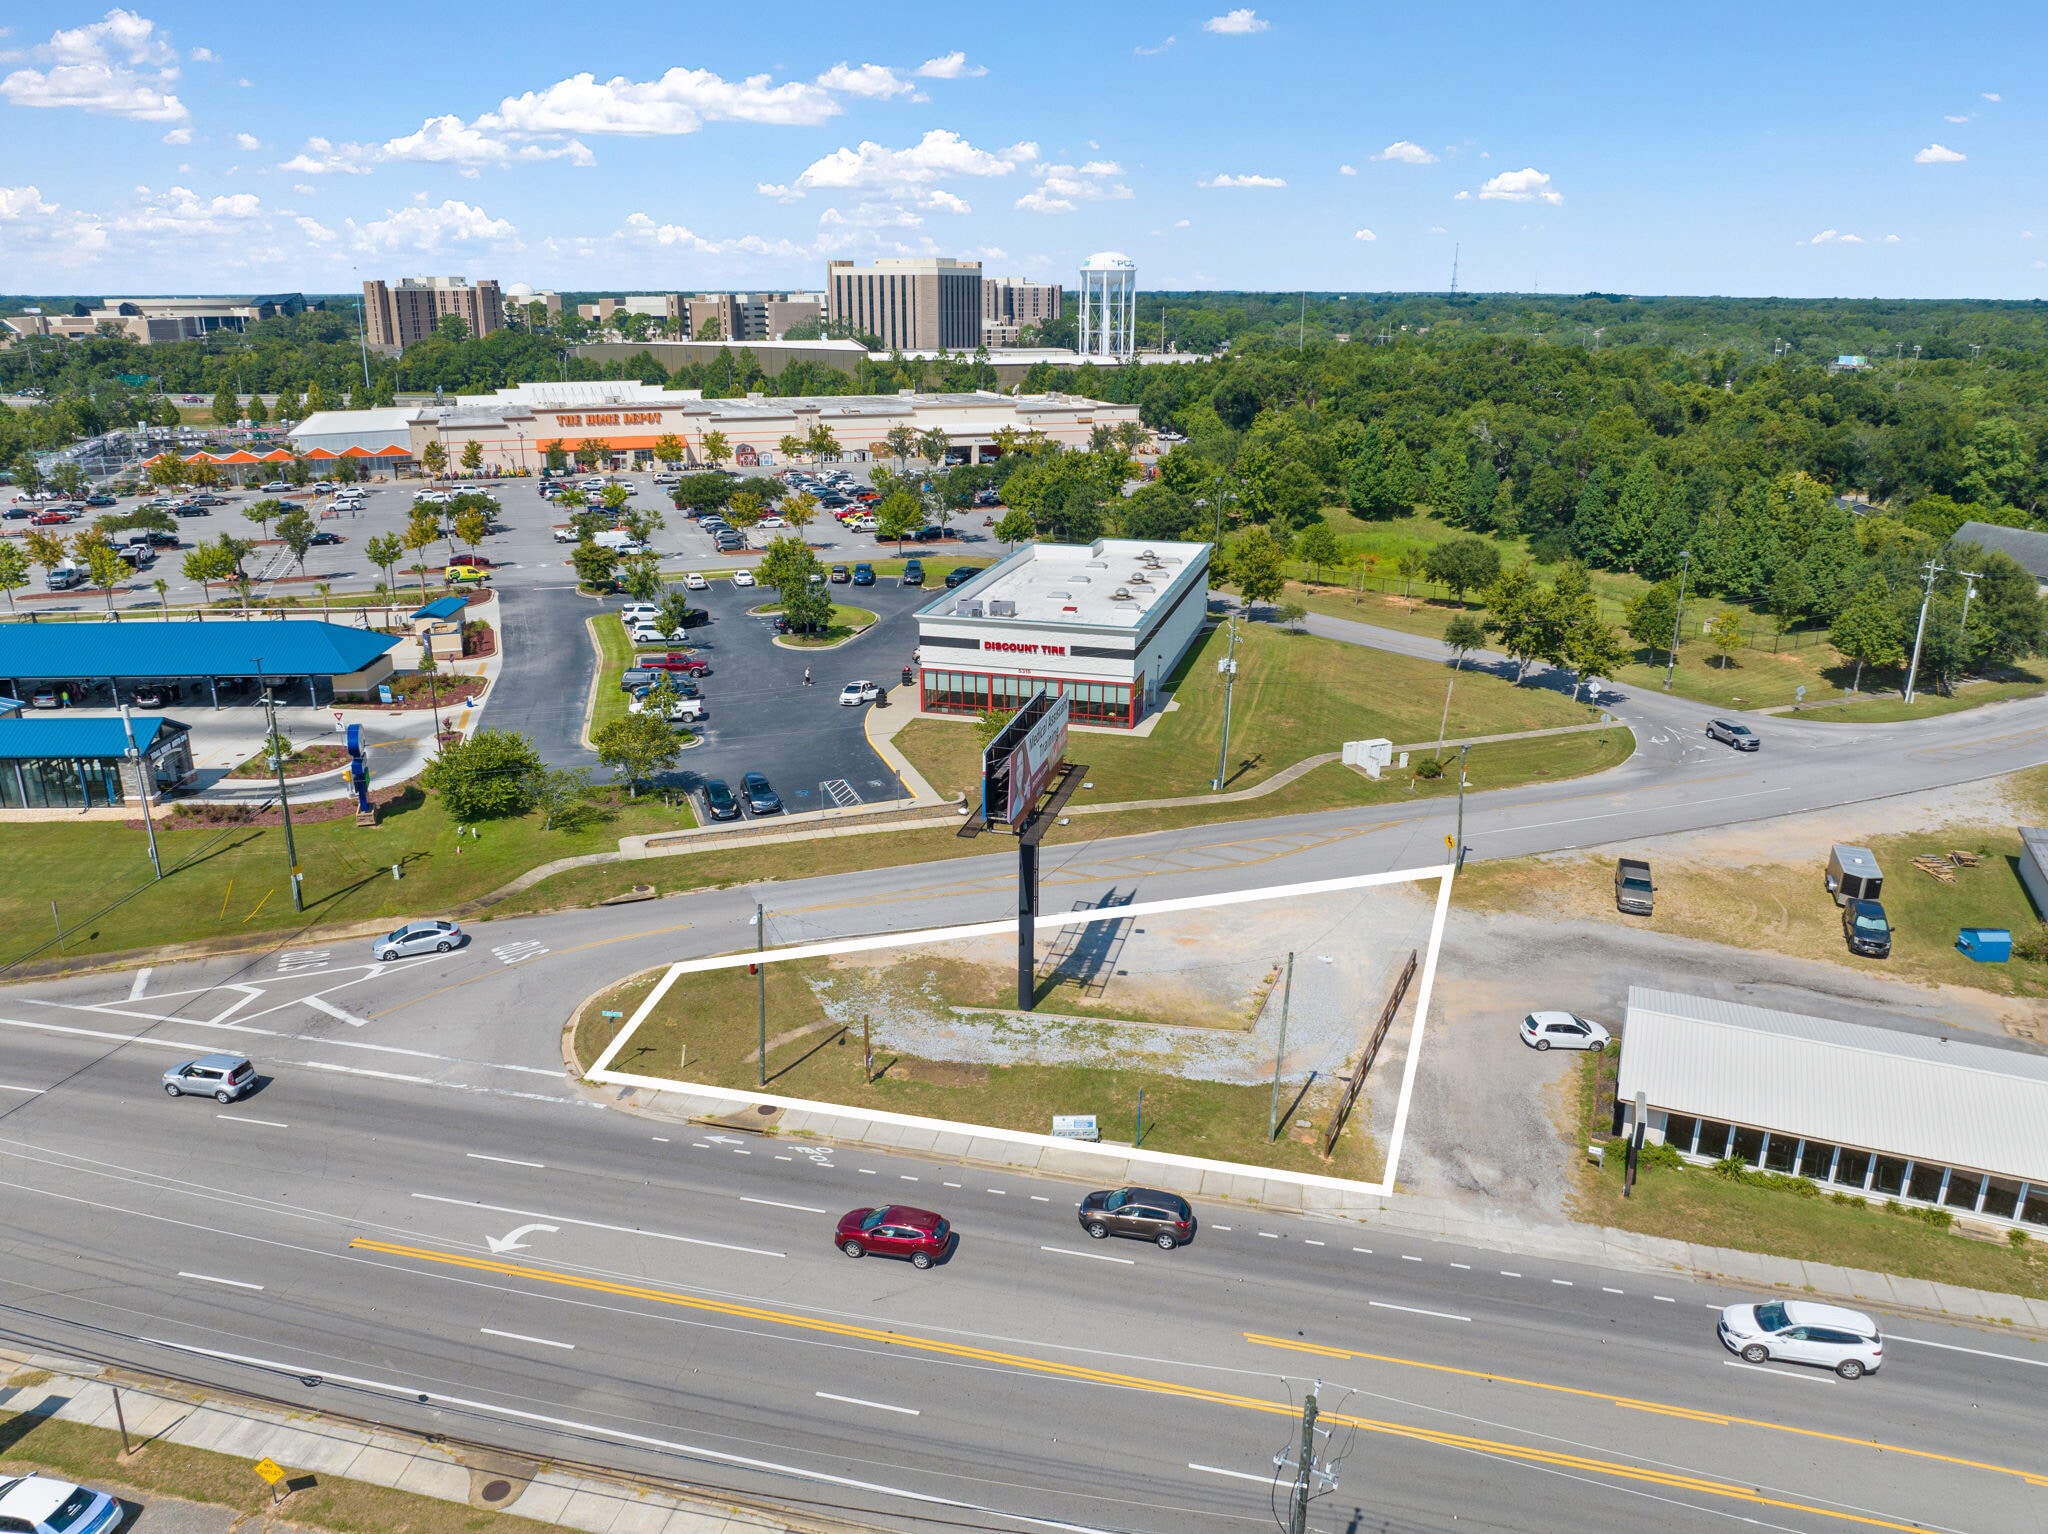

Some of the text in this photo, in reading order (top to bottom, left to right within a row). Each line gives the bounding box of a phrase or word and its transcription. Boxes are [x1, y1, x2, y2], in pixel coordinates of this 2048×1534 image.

[556, 412, 663, 427] THE HOME DEPOT
[984, 641, 1066, 656] DISCOUNT TIRE
